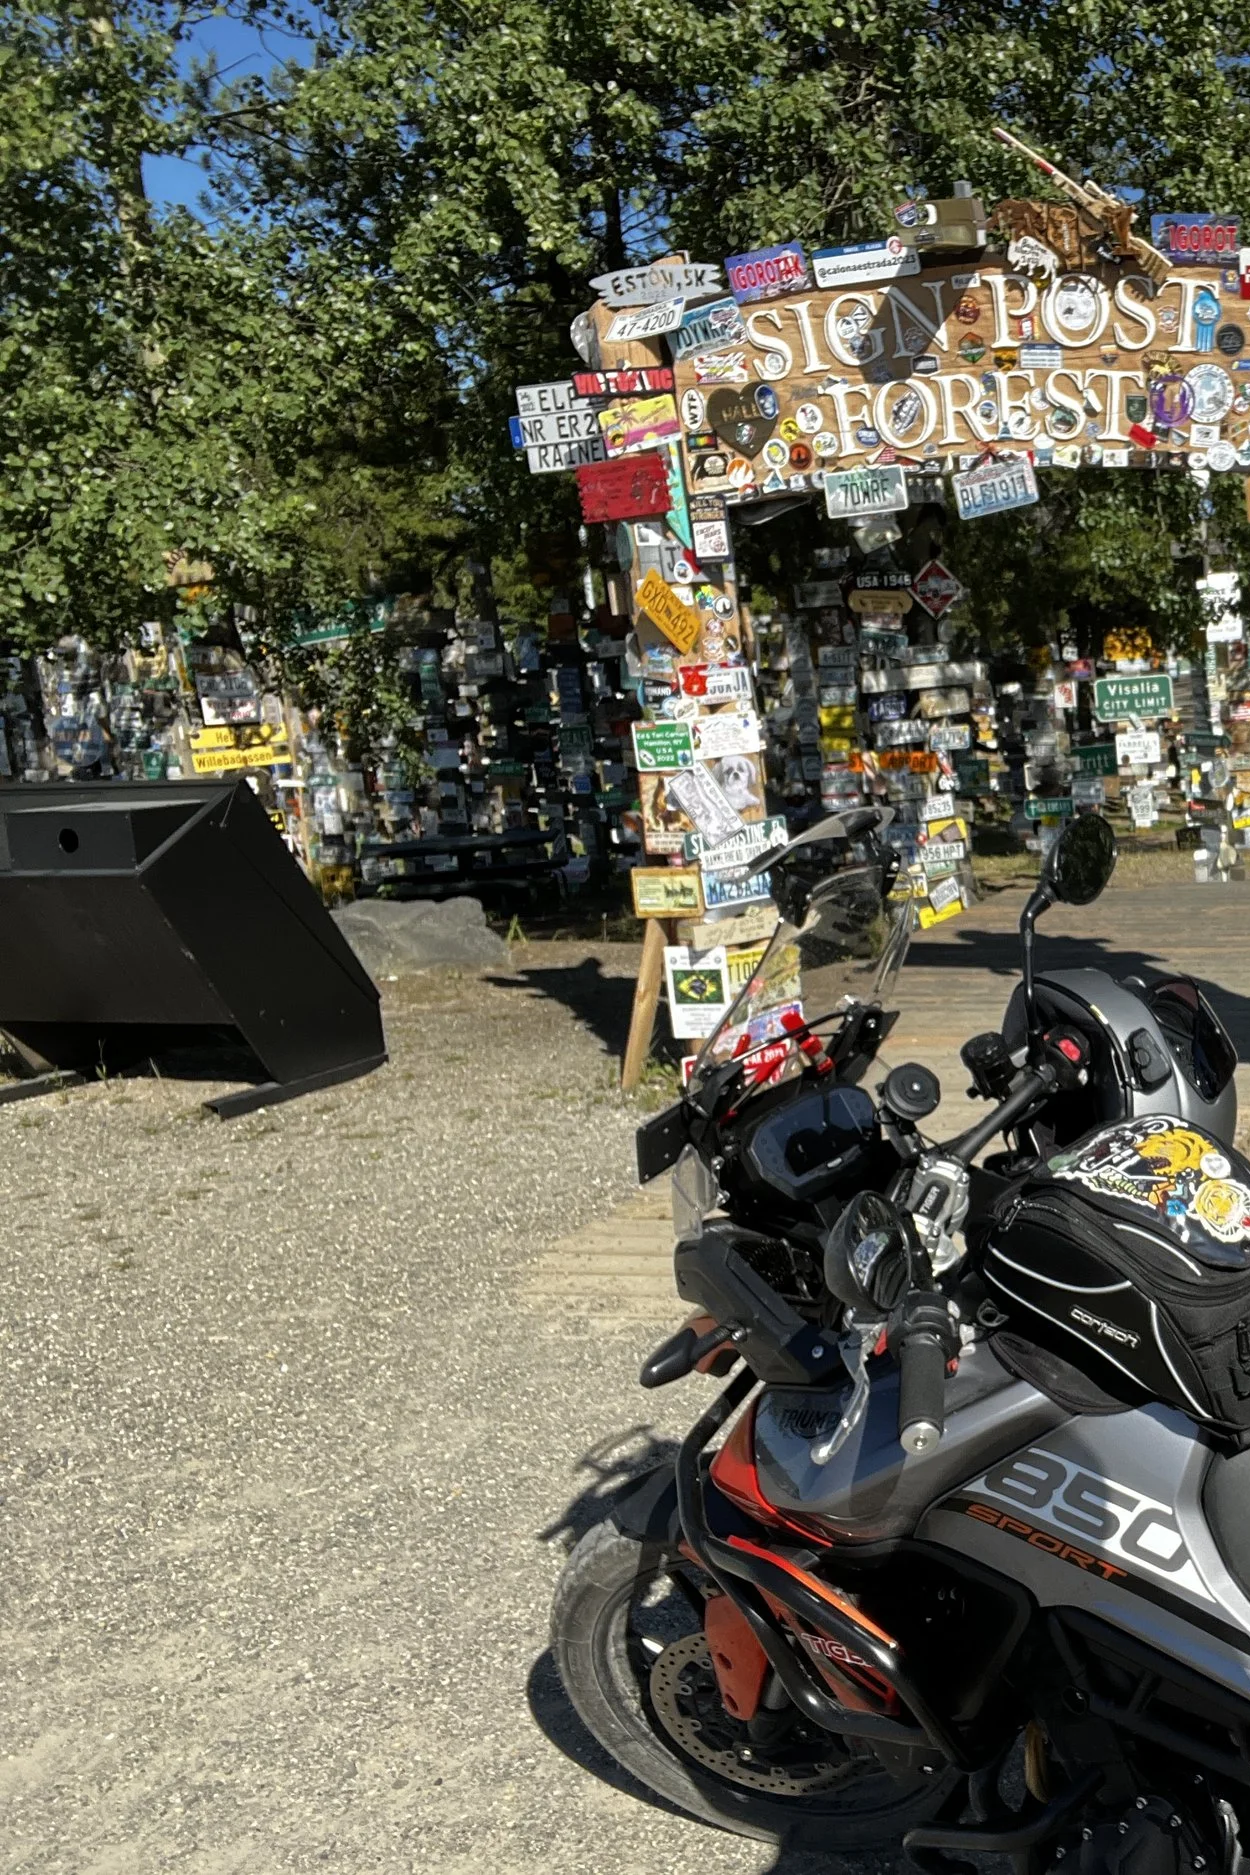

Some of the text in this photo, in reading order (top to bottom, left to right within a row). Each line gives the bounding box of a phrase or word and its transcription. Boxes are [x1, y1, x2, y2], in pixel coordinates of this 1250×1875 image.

[1168, 225, 1237, 251] IGOROT
[746, 273, 1220, 382] SIGN POST
[688, 393, 699, 426] WTF
[818, 368, 1145, 457] FOREST
[538, 439, 609, 469] RAINE
[839, 478, 890, 507] 7DWRF
[1103, 697, 1167, 711] CITY LIMIT
[1106, 682, 1161, 697] Visalia
[918, 1186, 940, 1214] TIGER
[780, 1408, 847, 1429] TRIUMP
[982, 1453, 1194, 1574] 850
[965, 1503, 1129, 1582] SPORT
